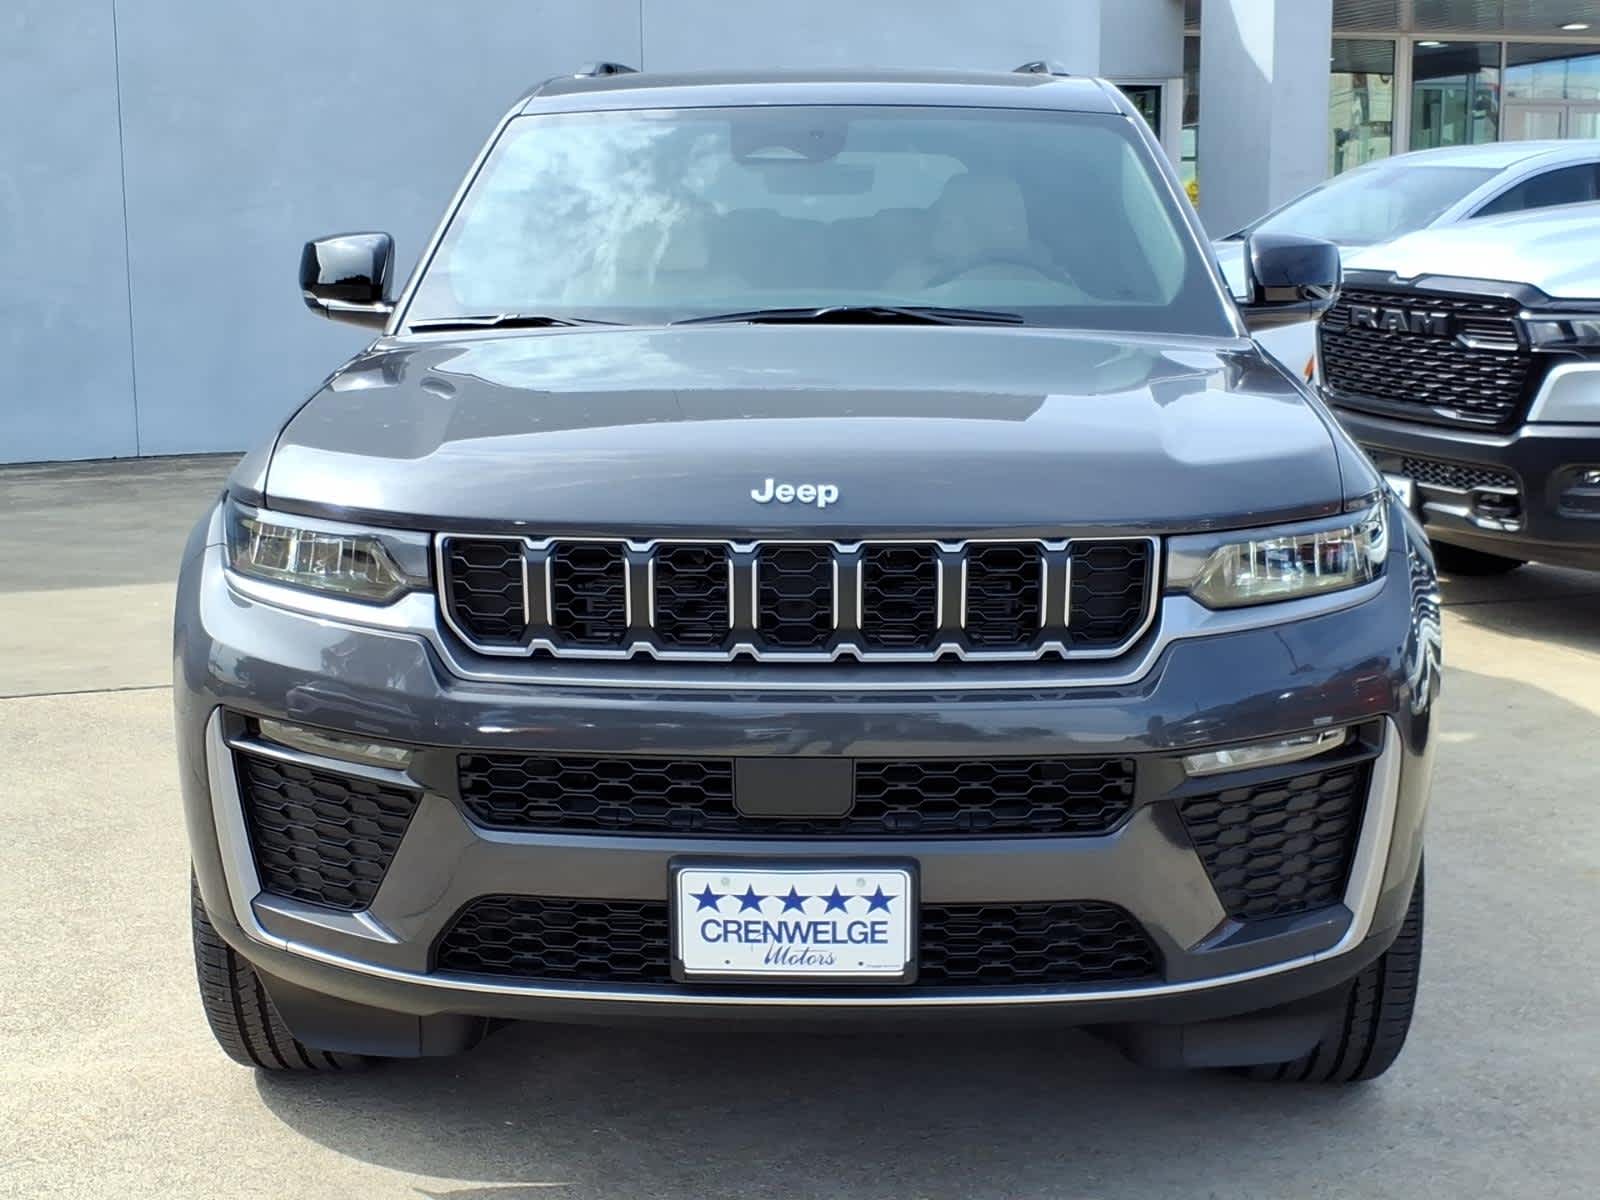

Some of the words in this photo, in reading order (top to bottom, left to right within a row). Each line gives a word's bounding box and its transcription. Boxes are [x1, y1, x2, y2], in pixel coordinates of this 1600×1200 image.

[1349, 305, 1449, 335] RAM
[750, 478, 839, 508] Jeep
[700, 918, 889, 945] CRENWELGE
[763, 942, 836, 966] Motors
